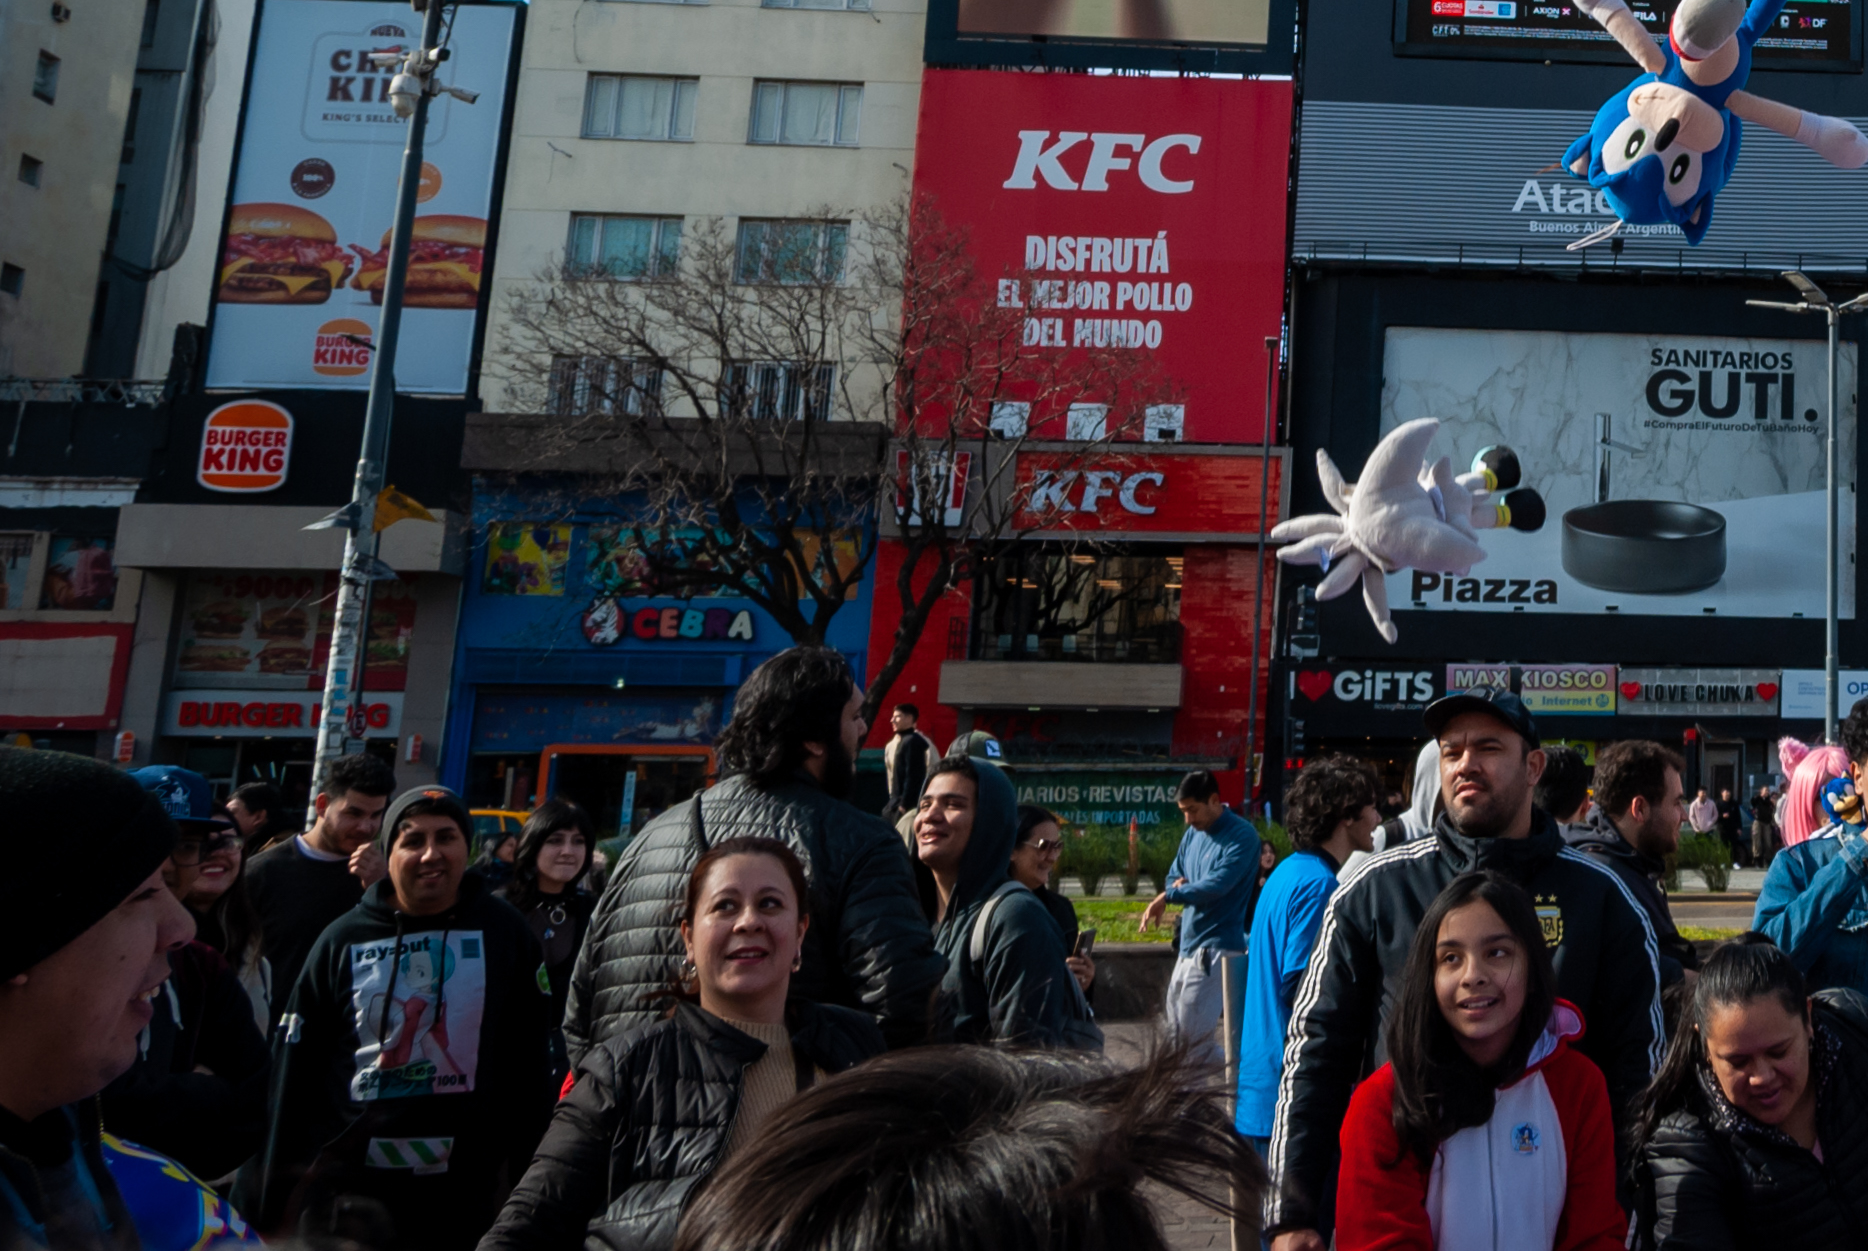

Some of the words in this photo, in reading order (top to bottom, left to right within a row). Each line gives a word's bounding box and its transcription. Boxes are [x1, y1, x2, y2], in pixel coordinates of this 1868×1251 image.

[1433, 1, 1442, 13] 6
[1533, 7, 1560, 16] AXION
[322, 113, 362, 122] KING'S
[1002, 129, 1202, 194] KFC
[1529, 220, 1580, 233] Buenos
[1024, 231, 1169, 274] DISFRUTÁ
[996, 278, 1024, 309] EL
[1030, 279, 1110, 311] MEJOR
[1115, 282, 1193, 312] POLLO
[1022, 317, 1067, 347] DEL
[1073, 318, 1163, 350] MUNDO
[314, 348, 370, 366] KING
[1650, 348, 1793, 371] SANITARIOS
[1646, 369, 1818, 422] GUTI.
[1643, 420, 1819, 435] #CompraElFuturoDeTuBañoHoy
[206, 429, 288, 448] BURGER
[202, 448, 285, 473] KING
[1024, 469, 1165, 516] KFC
[1411, 568, 1558, 605] Piazza
[633, 607, 754, 641] CEBRA
[1521, 670, 1608, 689] KIOSCO
[1541, 694, 1593, 707] Internet
[1644, 684, 1689, 702] LOVE
[1695, 683, 1755, 702] CHUKA
[179, 701, 302, 728] BURGER
[1016, 785, 1080, 803] IARIOS
[1088, 785, 1179, 804] REVISTAS
[1092, 810, 1161, 826] IMPORTADAS
